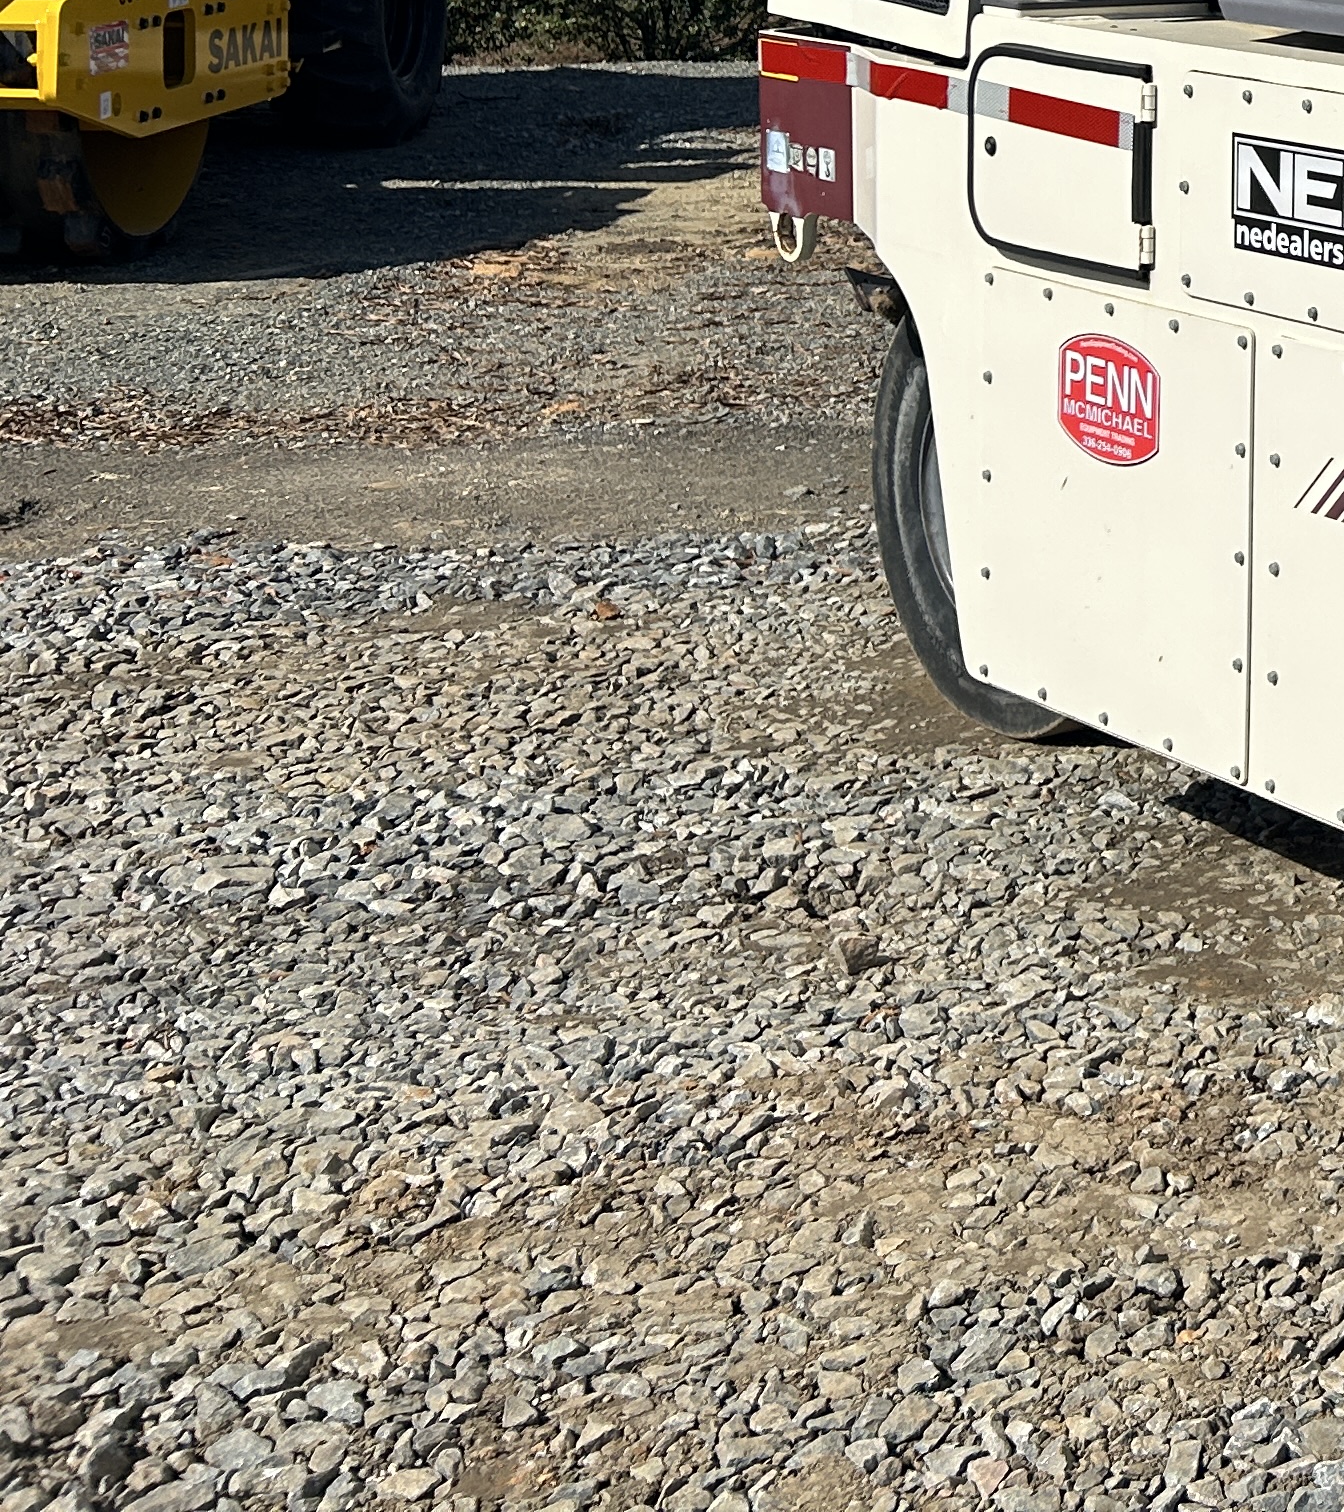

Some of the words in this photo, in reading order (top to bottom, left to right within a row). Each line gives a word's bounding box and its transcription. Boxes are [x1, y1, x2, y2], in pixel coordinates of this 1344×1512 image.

[207, 17, 283, 74] SAKAI
[1064, 349, 1154, 420] PENN
[1063, 397, 1153, 440] MCMICHAEL
